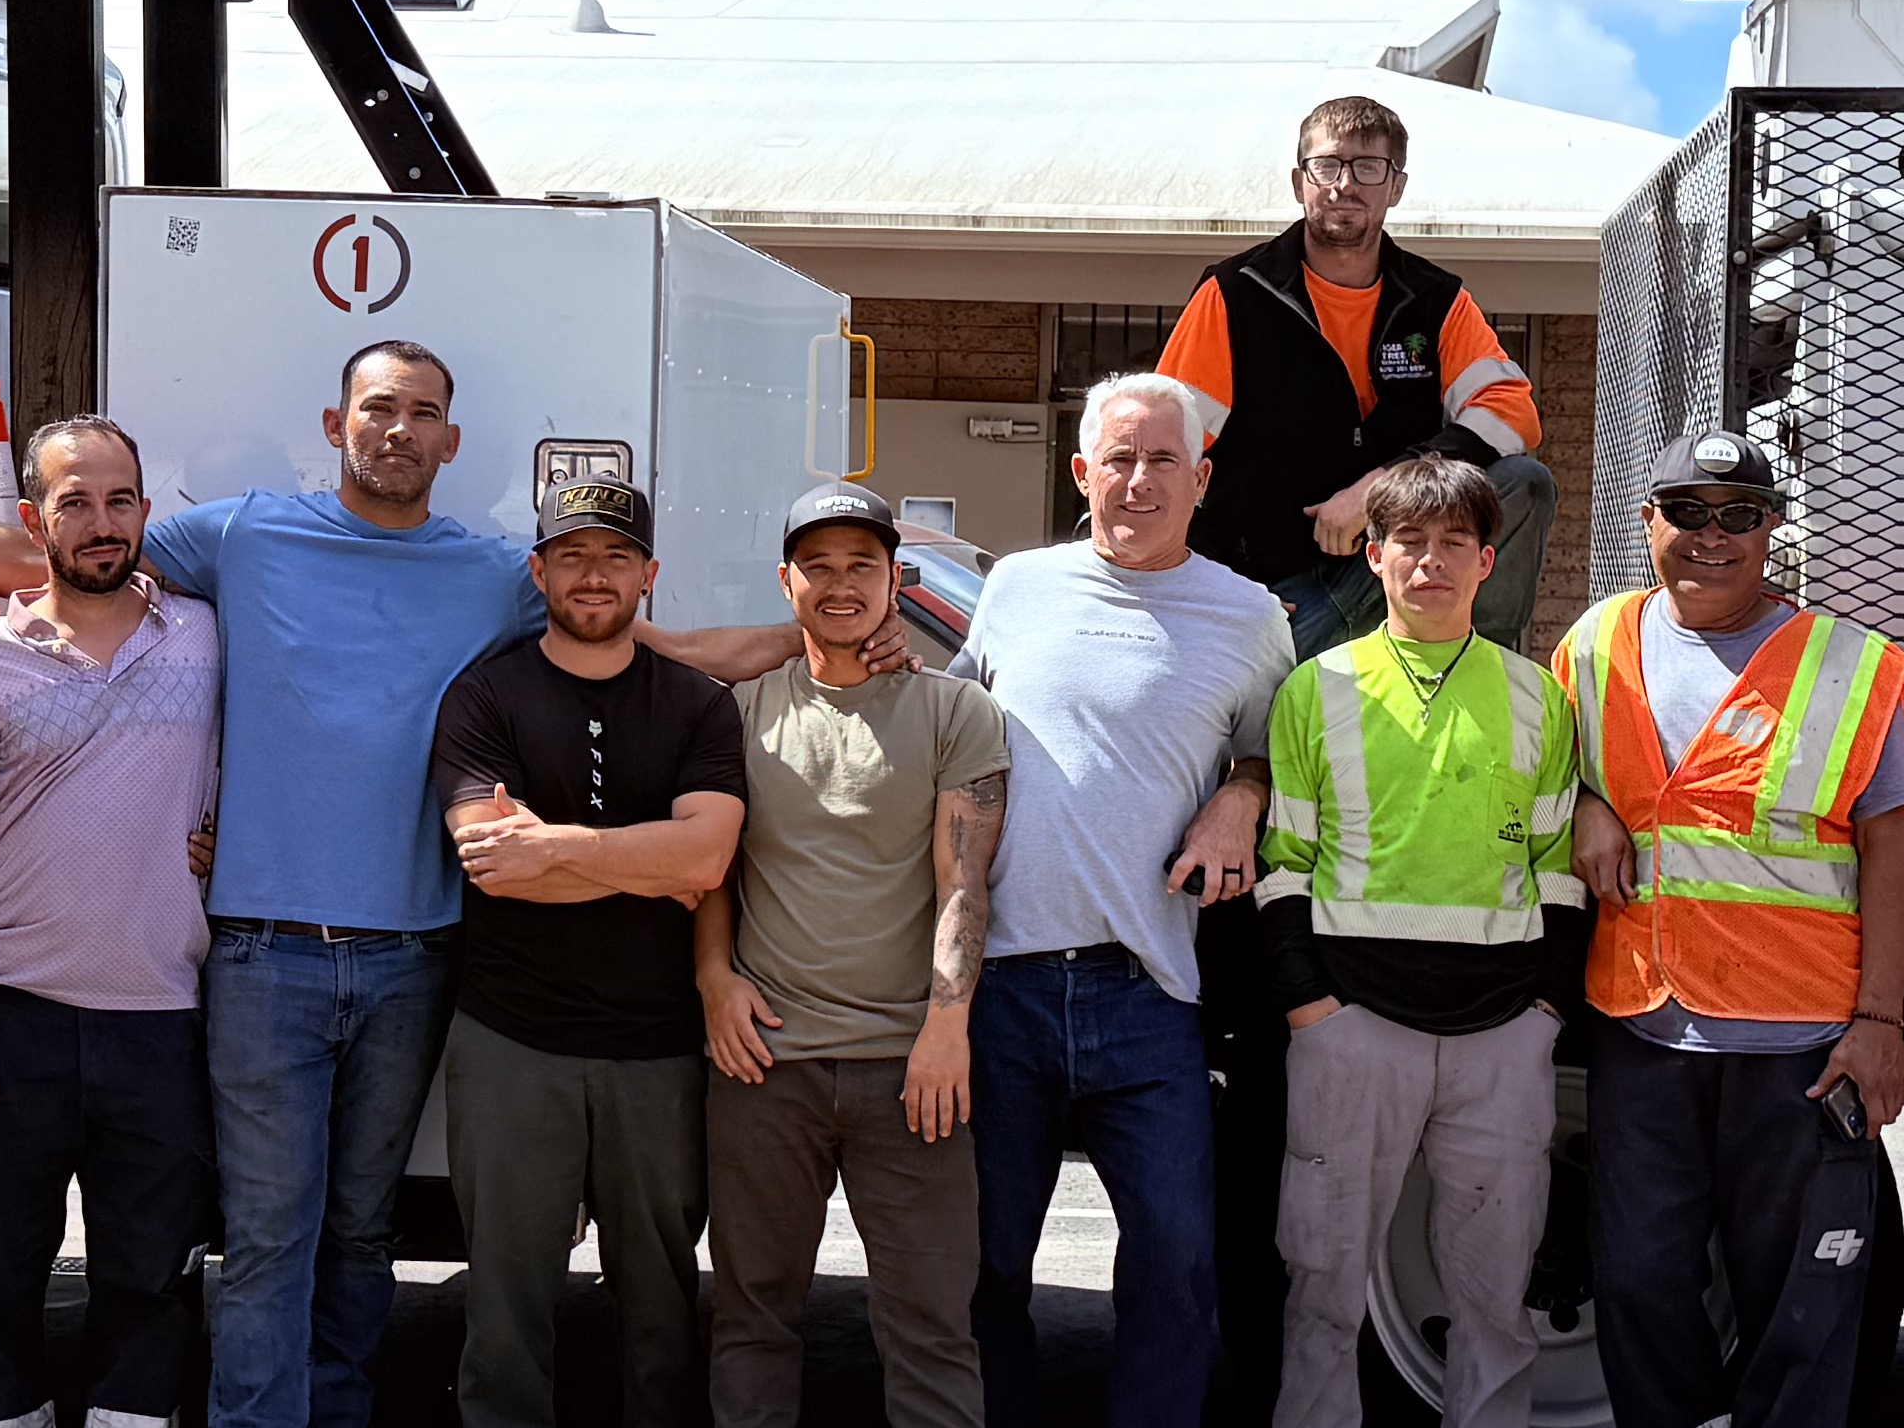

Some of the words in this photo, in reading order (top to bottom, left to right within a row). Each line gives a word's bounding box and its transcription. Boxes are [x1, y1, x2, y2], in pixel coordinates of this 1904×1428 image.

[353, 236, 369, 293] 1
[562, 486, 628, 505] KING
[590, 747, 603, 811] FOX
